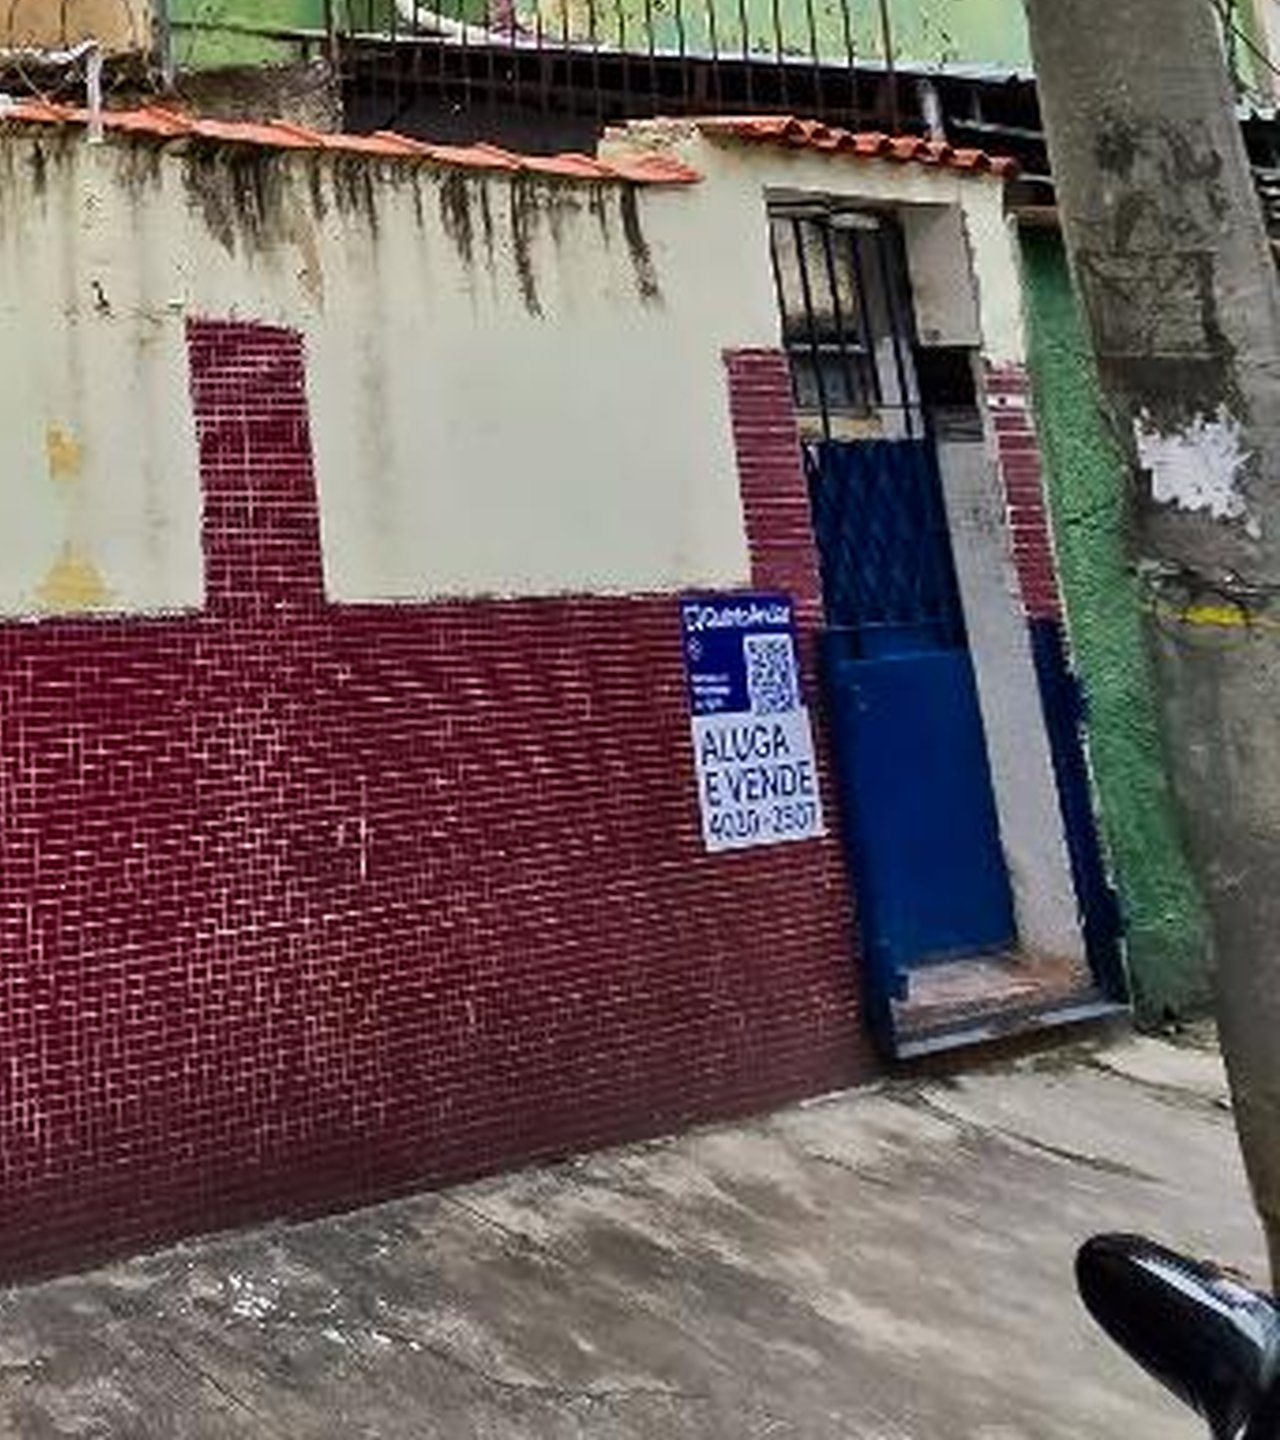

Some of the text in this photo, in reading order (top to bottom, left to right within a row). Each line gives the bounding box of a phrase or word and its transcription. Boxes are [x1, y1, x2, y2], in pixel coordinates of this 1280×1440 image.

[702, 723, 791, 765] ALUGA
[705, 760, 815, 807] E VENDE
